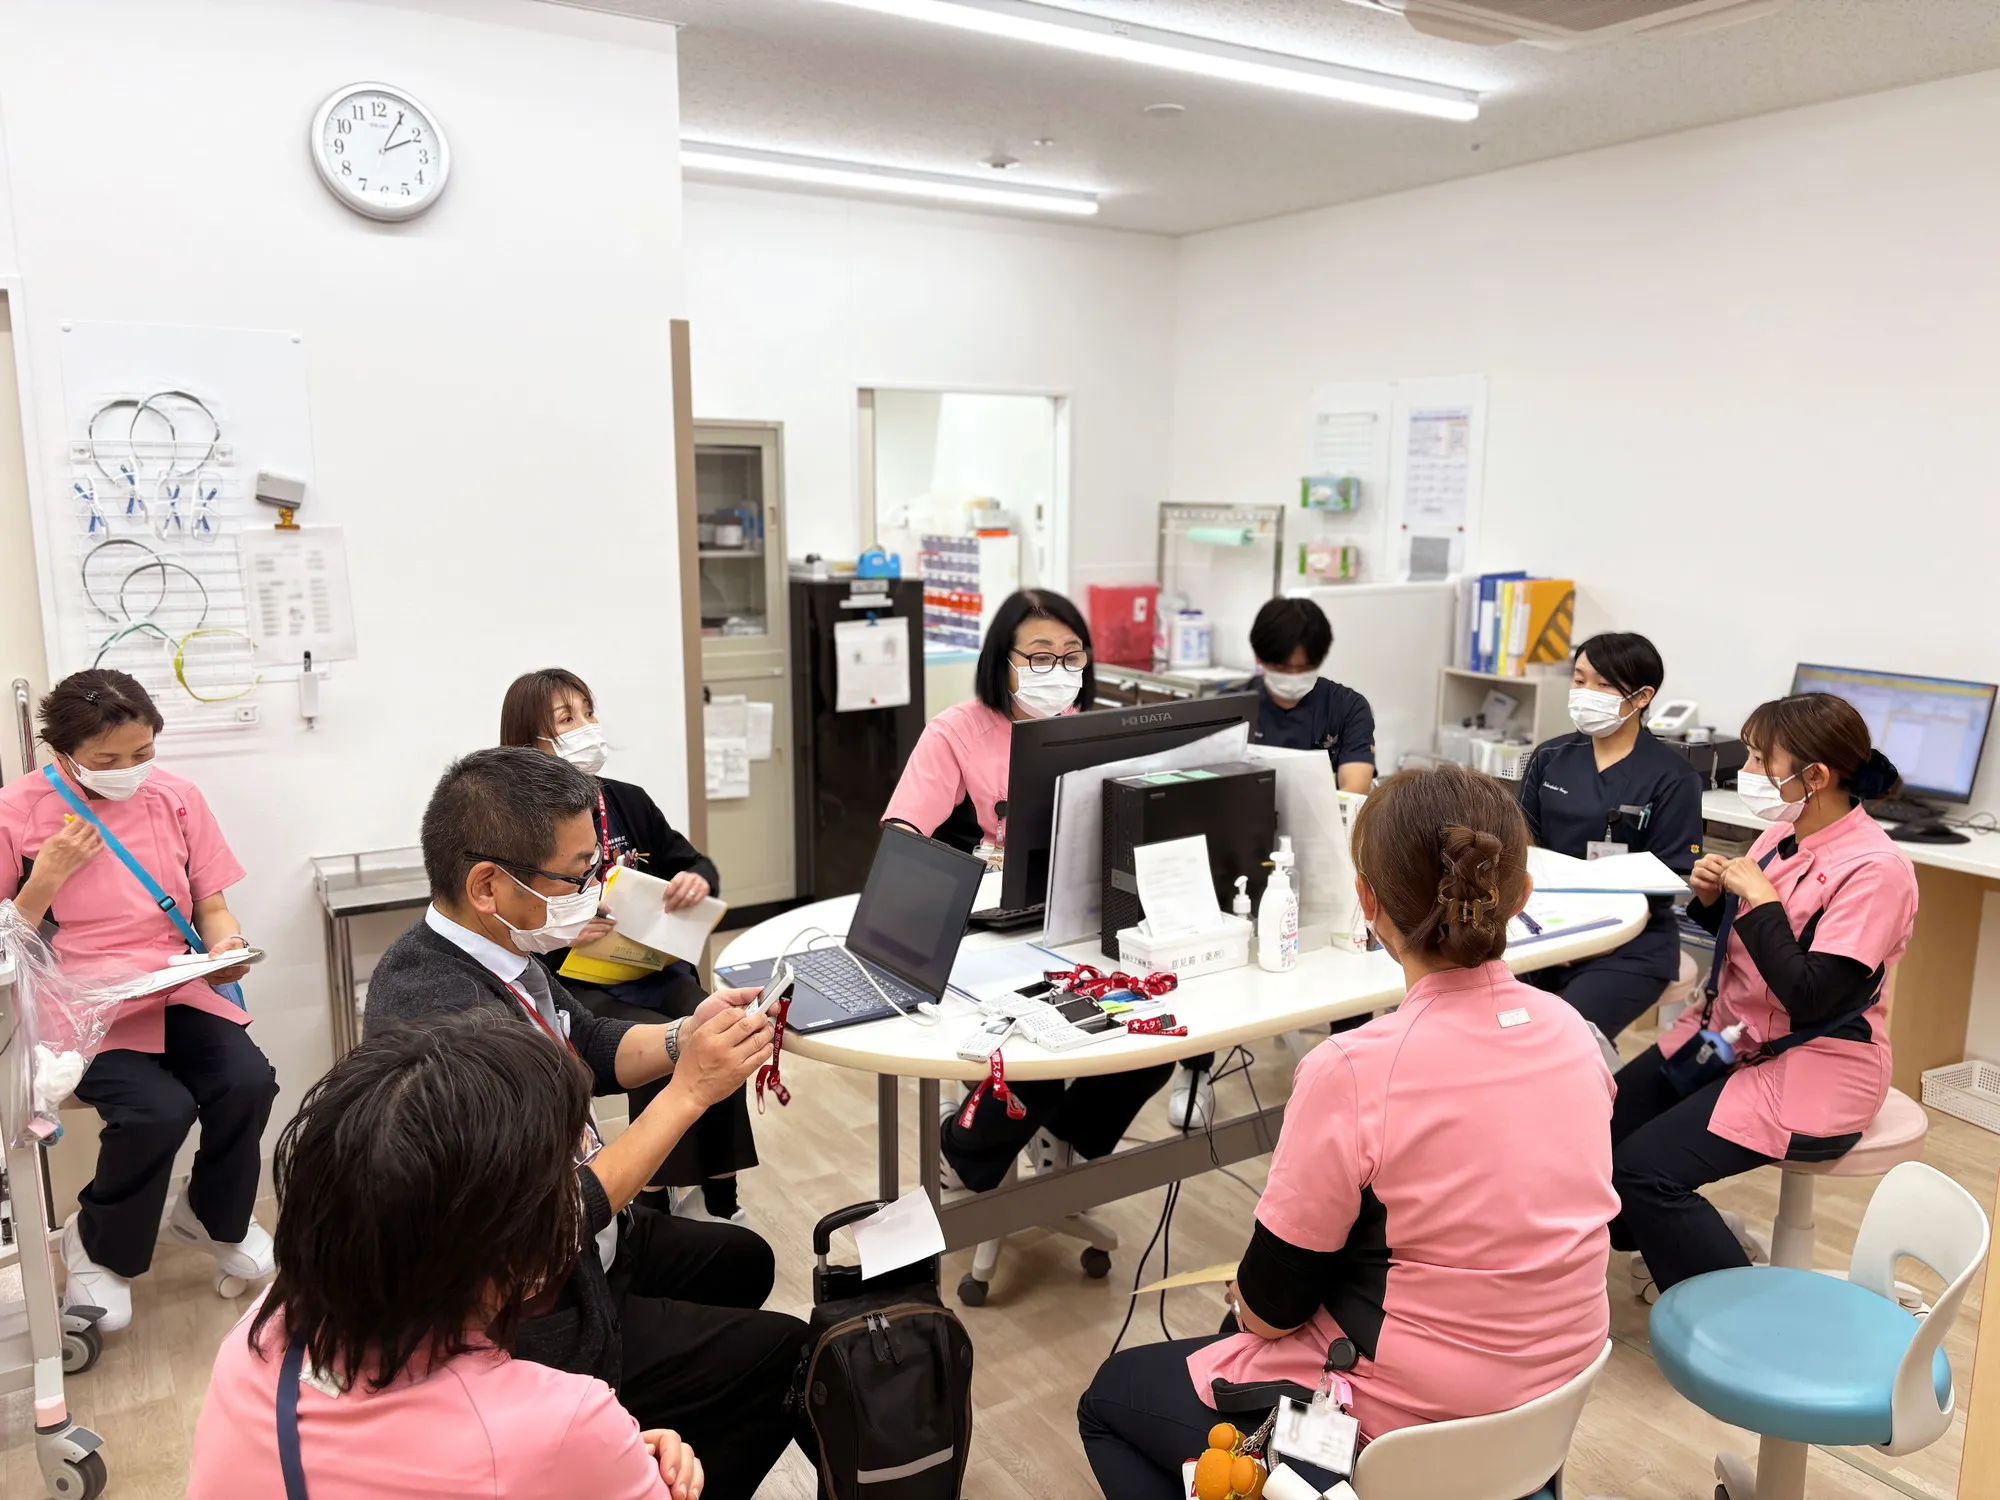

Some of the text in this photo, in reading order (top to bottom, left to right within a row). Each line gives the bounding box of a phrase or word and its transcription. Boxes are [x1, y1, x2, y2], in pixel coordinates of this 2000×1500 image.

[352, 104, 365, 121] 11
[371, 102, 387, 118] 12
[337, 118, 352, 135] 10
[412, 127, 422, 143] 2
[333, 138, 344, 155] 9
[419, 148, 429, 165] 3
[341, 160, 352, 176] 8
[358, 177, 368, 192] 7
[414, 169, 424, 185] 4
[401, 182, 411, 196] 5
[1139, 712, 1173, 724] DATA
